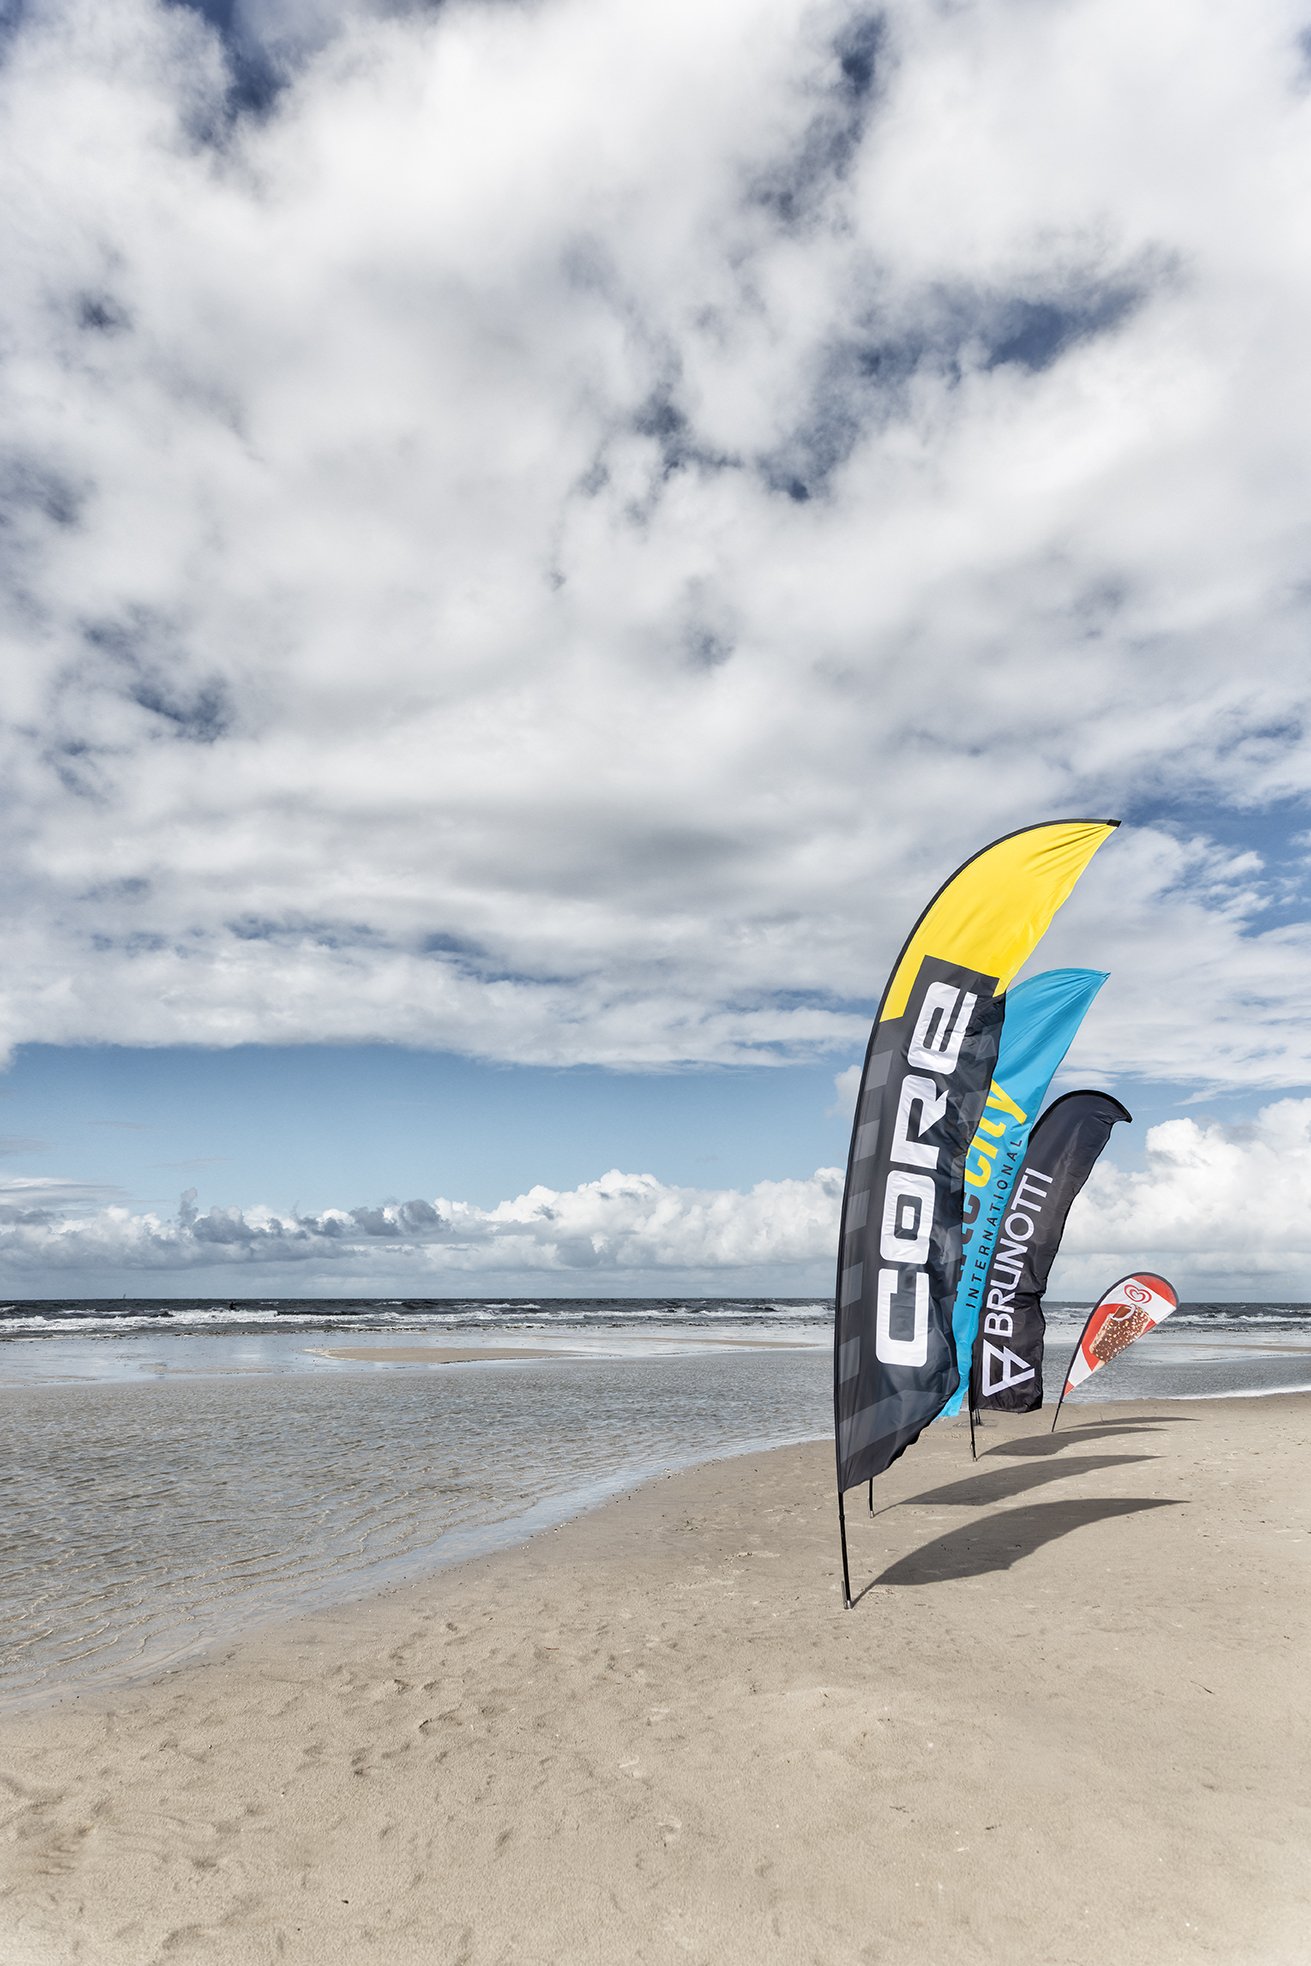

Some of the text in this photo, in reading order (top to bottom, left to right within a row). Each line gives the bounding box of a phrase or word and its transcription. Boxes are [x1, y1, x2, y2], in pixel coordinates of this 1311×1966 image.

[875, 981, 978, 1367] CORE
[965, 1139, 1023, 1309] INTERNATIONAL
[983, 1167, 1054, 1338] BRUNOTTI
